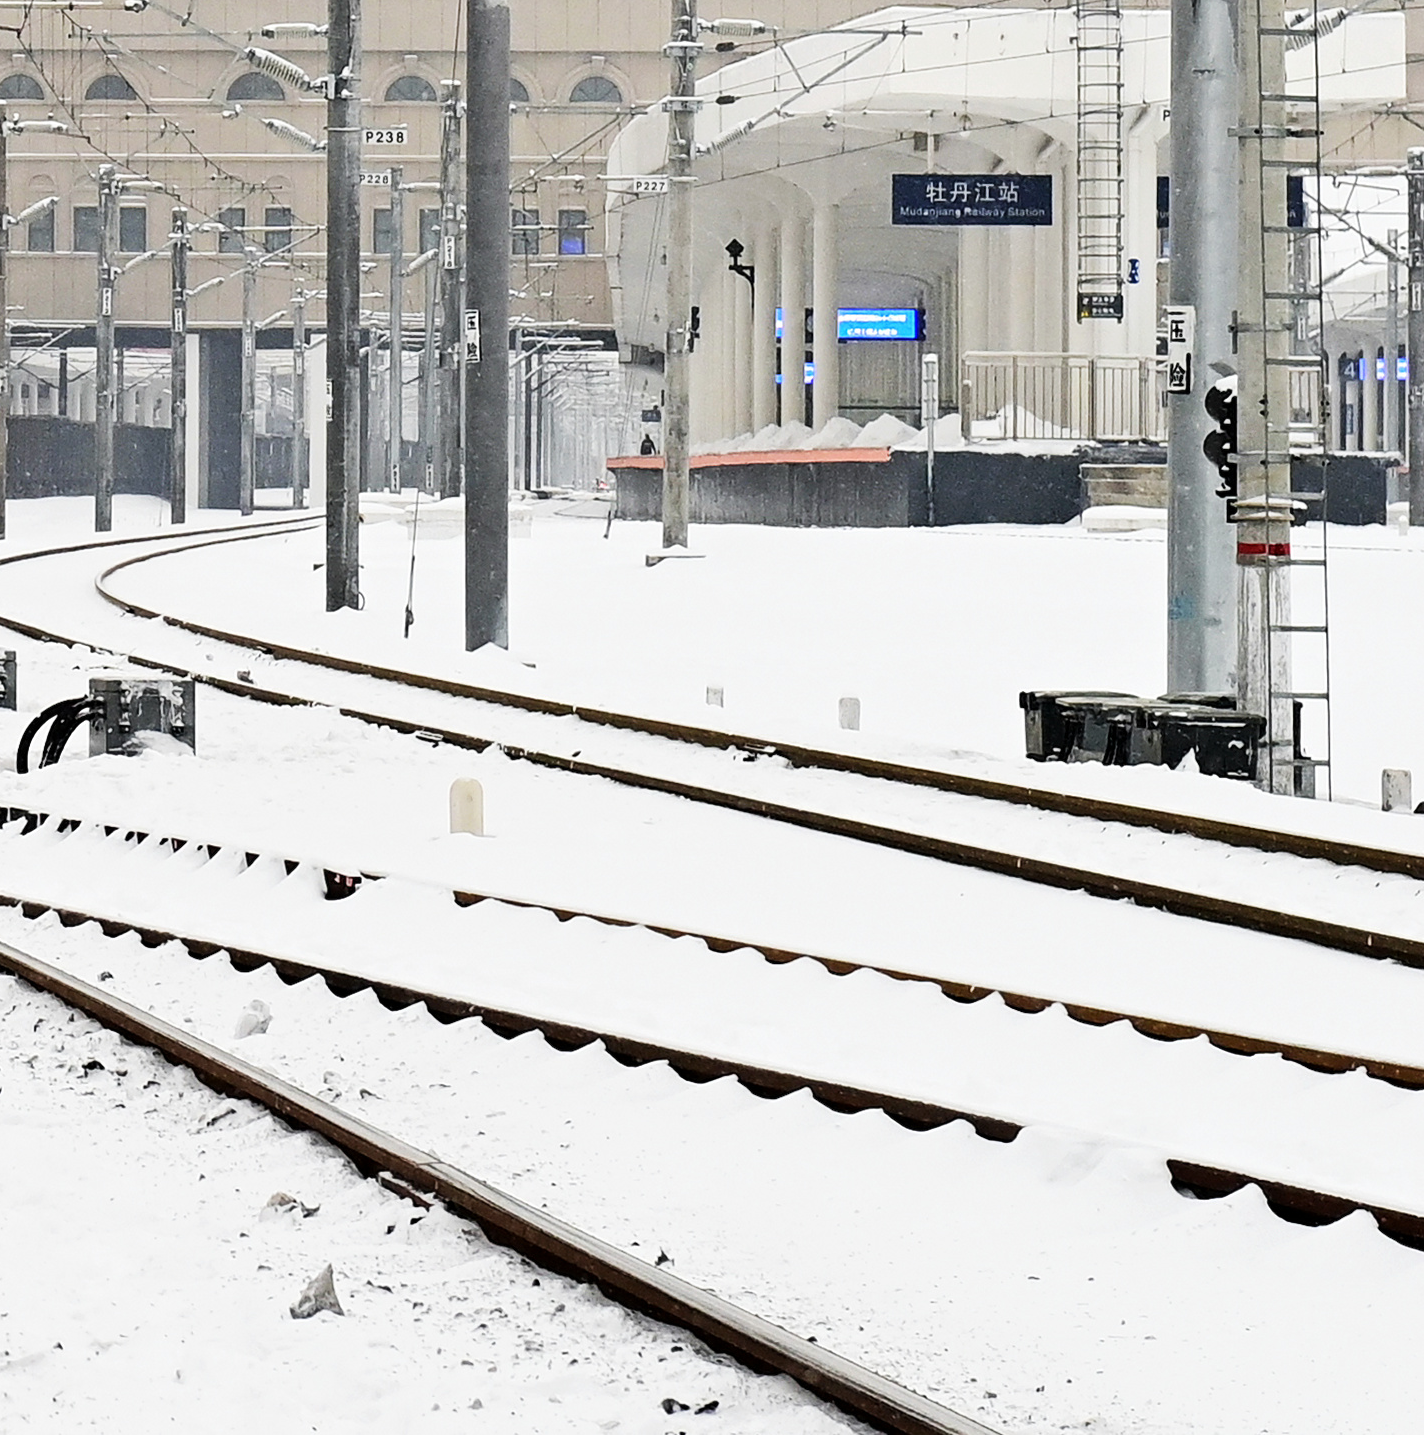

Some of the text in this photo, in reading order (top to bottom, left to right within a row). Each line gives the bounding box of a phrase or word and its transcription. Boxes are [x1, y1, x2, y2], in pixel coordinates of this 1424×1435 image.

[365, 131, 404, 143] P238
[359, 174, 389, 184] P228
[636, 181, 665, 191] P227
[925, 181, 1020, 203] 牡丹江站
[900, 207, 1045, 218] Mudanjiang Railway Station
[1344, 362, 1355, 376] 4
